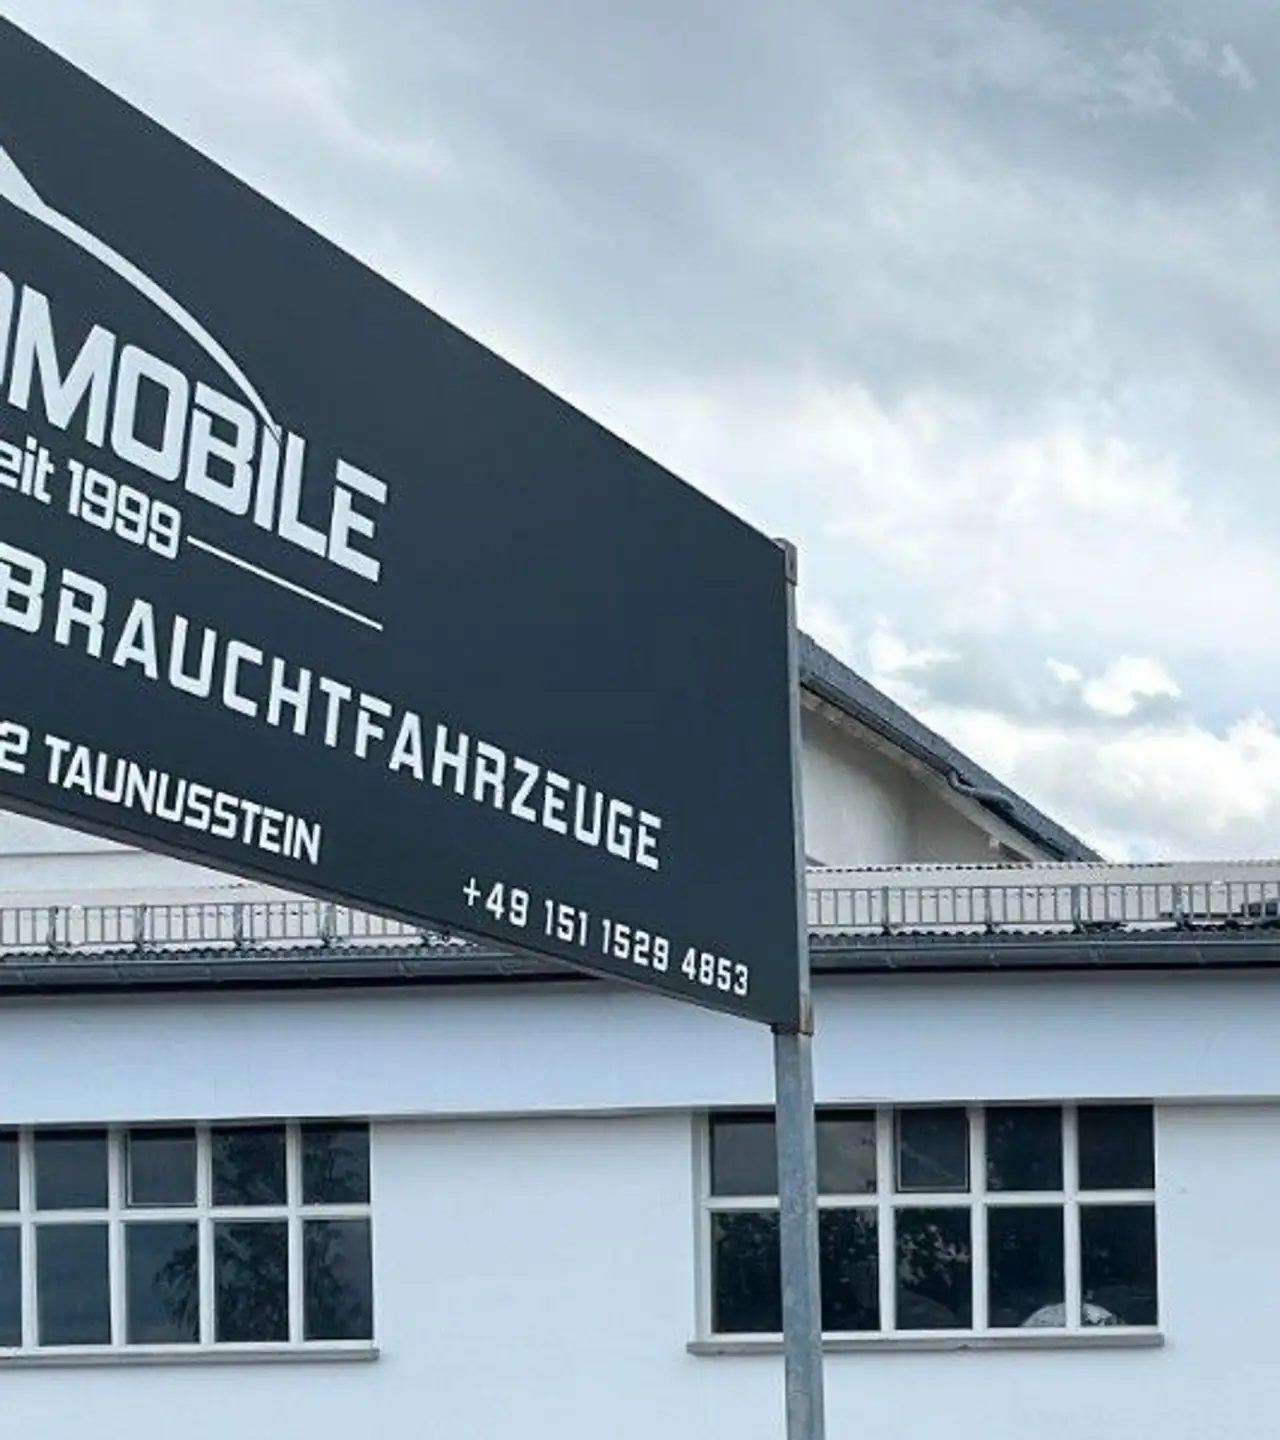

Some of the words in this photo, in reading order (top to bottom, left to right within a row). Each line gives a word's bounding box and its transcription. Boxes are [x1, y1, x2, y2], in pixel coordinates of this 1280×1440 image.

[67, 458, 181, 560] 1999
[0, 541, 661, 870] BRAUCHTFAHRZEUGE
[44, 734, 321, 865] TAUNUSSTEIN
[463, 877, 529, 927] +49
[545, 899, 588, 946] 151
[602, 919, 669, 972] 1529
[681, 947, 748, 996] 4853
